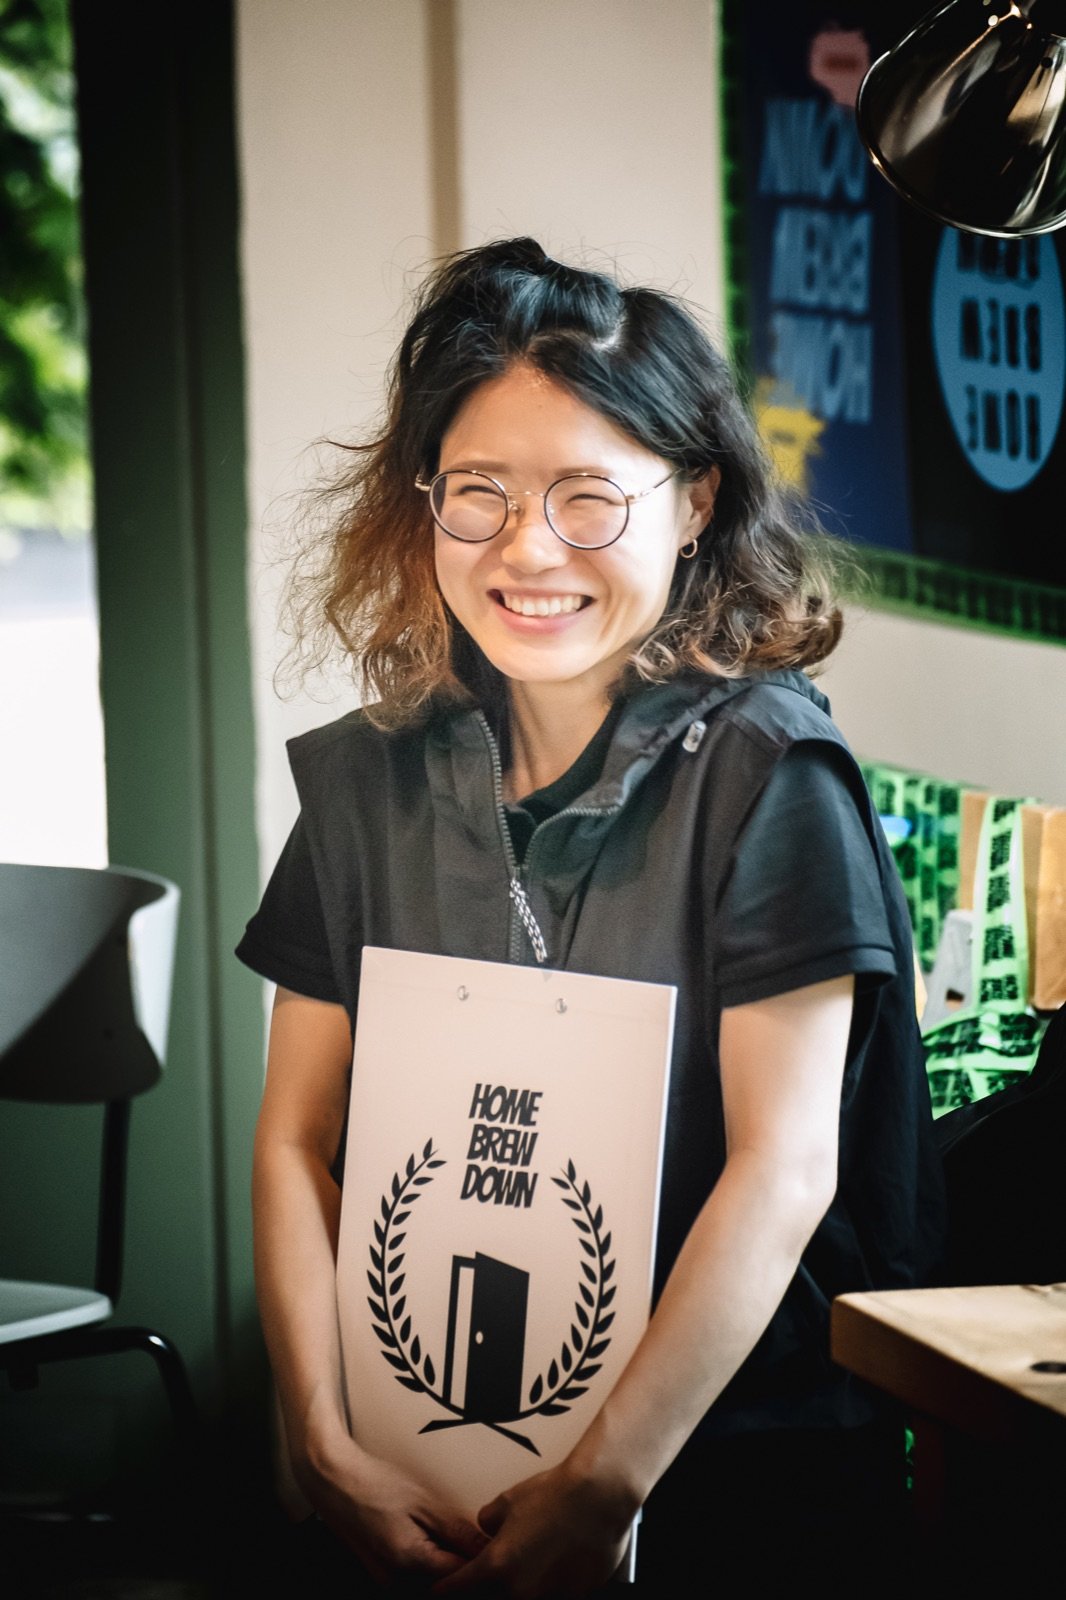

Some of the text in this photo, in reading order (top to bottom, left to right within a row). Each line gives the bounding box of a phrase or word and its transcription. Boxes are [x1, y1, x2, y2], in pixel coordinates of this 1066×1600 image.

[468, 1083, 543, 1126] HOME
[466, 1123, 539, 1167] BREW
[460, 1164, 539, 1209] DOWN
